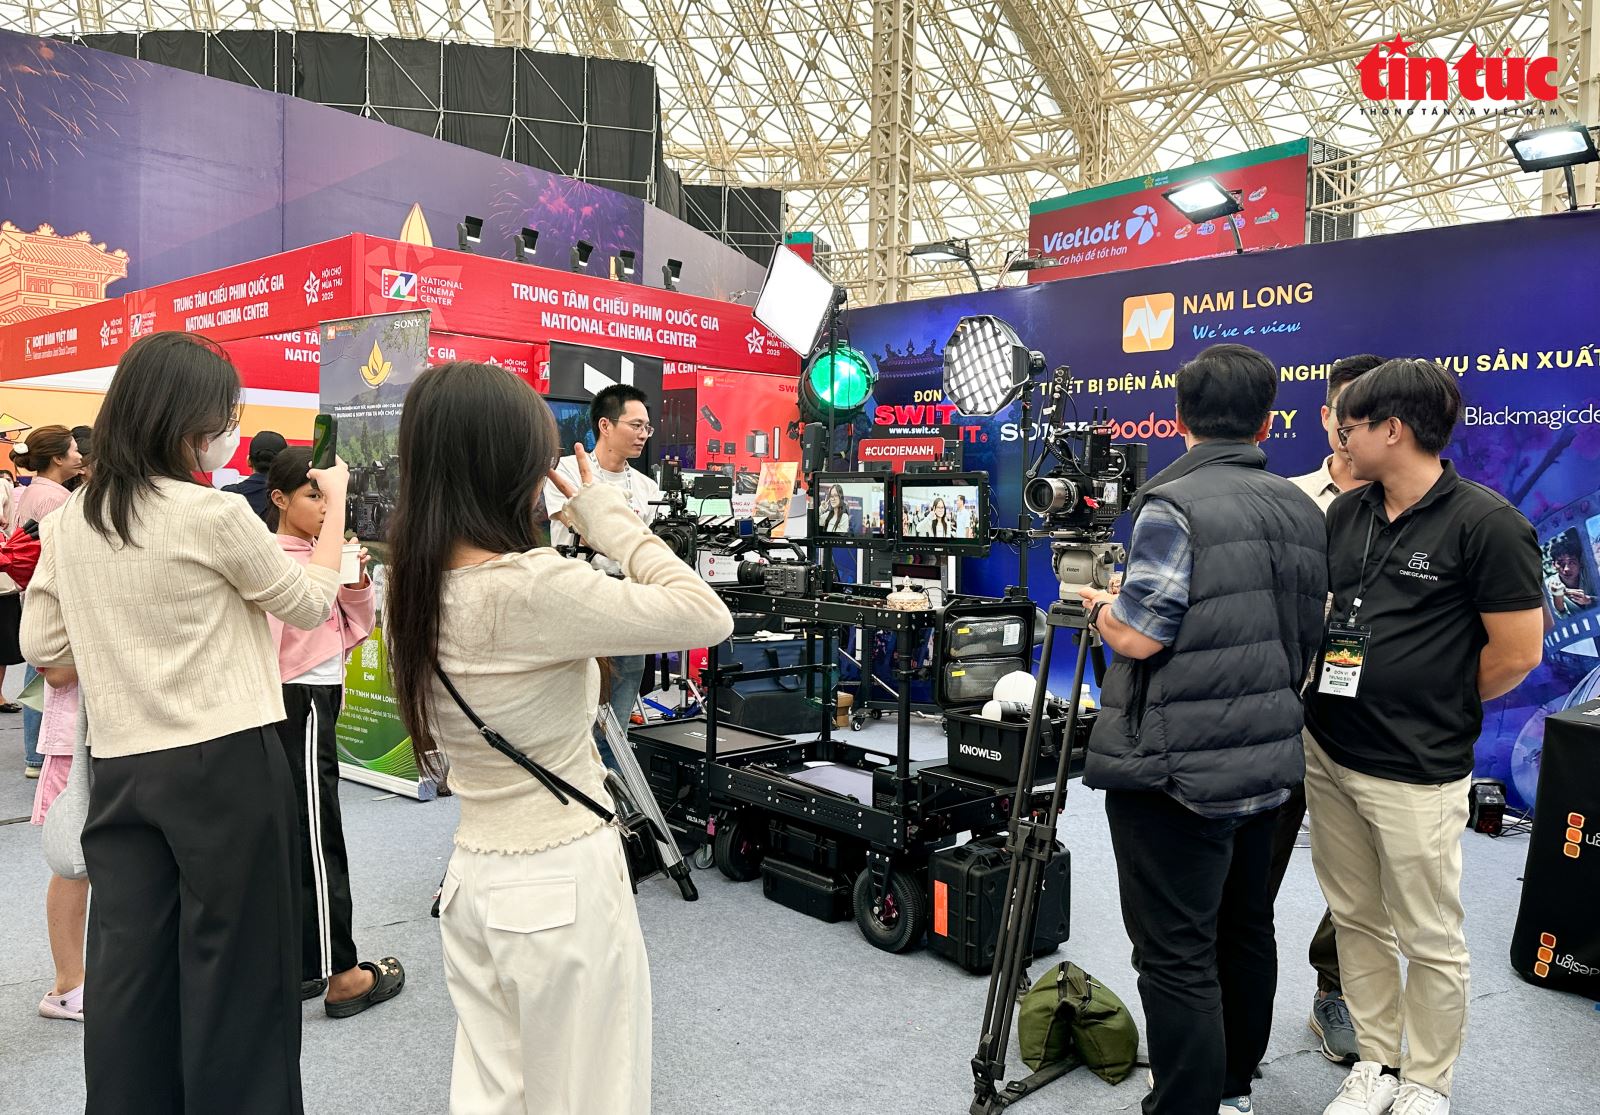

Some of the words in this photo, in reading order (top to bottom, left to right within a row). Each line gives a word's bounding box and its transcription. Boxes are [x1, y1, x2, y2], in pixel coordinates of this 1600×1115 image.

[1043, 220, 1121, 253] Vietlott
[1071, 253, 1083, 264] hội
[1097, 247, 1109, 258] tốt
[1111, 246, 1127, 256] hơn
[322, 269, 330, 279] HỘI
[330, 266, 342, 277] CHỢ
[322, 280, 332, 290] MÙA
[333, 278, 343, 287] THU
[420, 276, 463, 290] NATIONAL
[173, 296, 193, 313] TRUNG
[195, 290, 208, 307] TÂM
[209, 283, 228, 305] CHIẾU
[229, 282, 246, 301] PHIM
[248, 273, 269, 297] QUỐC
[271, 274, 284, 291] GIA
[322, 292, 334, 301] 2025
[420, 285, 455, 297] CINEMA
[420, 295, 452, 306] CENTER
[1183, 290, 1234, 315] NAM
[1243, 282, 1313, 309] LONG
[511, 283, 558, 305] TRUNG
[562, 290, 589, 310] TÂM
[593, 296, 629, 316] CHIẾU
[632, 303, 662, 322] PHIM
[665, 309, 698, 328] QUỐC
[700, 315, 719, 331] GIA
[185, 315, 215, 332] NATIONAL
[216, 307, 241, 326] CINEMA
[243, 302, 269, 321] CENTER
[394, 318, 421, 329] SONY
[541, 311, 605, 335] NATIONAL
[607, 321, 653, 342] CINEMA
[656, 329, 697, 348] CENTER
[1193, 323, 1239, 340] We've
[1244, 327, 1256, 336] a
[1260, 320, 1301, 334] view
[285, 348, 320, 363] NATIO
[437, 347, 457, 360] GIA
[914, 389, 942, 402] ĐƠN
[1088, 378, 1103, 396] BỊ
[1107, 372, 1146, 394] ĐIỆN
[1151, 370, 1176, 390] ẢN
[1476, 348, 1528, 372] SẢN
[874, 405, 957, 425] SWIT
[889, 426, 940, 434] www.swit.cc
[865, 445, 934, 456] #CUCDIENANH
[1399, 569, 1438, 581] CINEGEARVN
[370, 693, 382, 701] NAM
[960, 744, 1002, 761] KNOWLED
